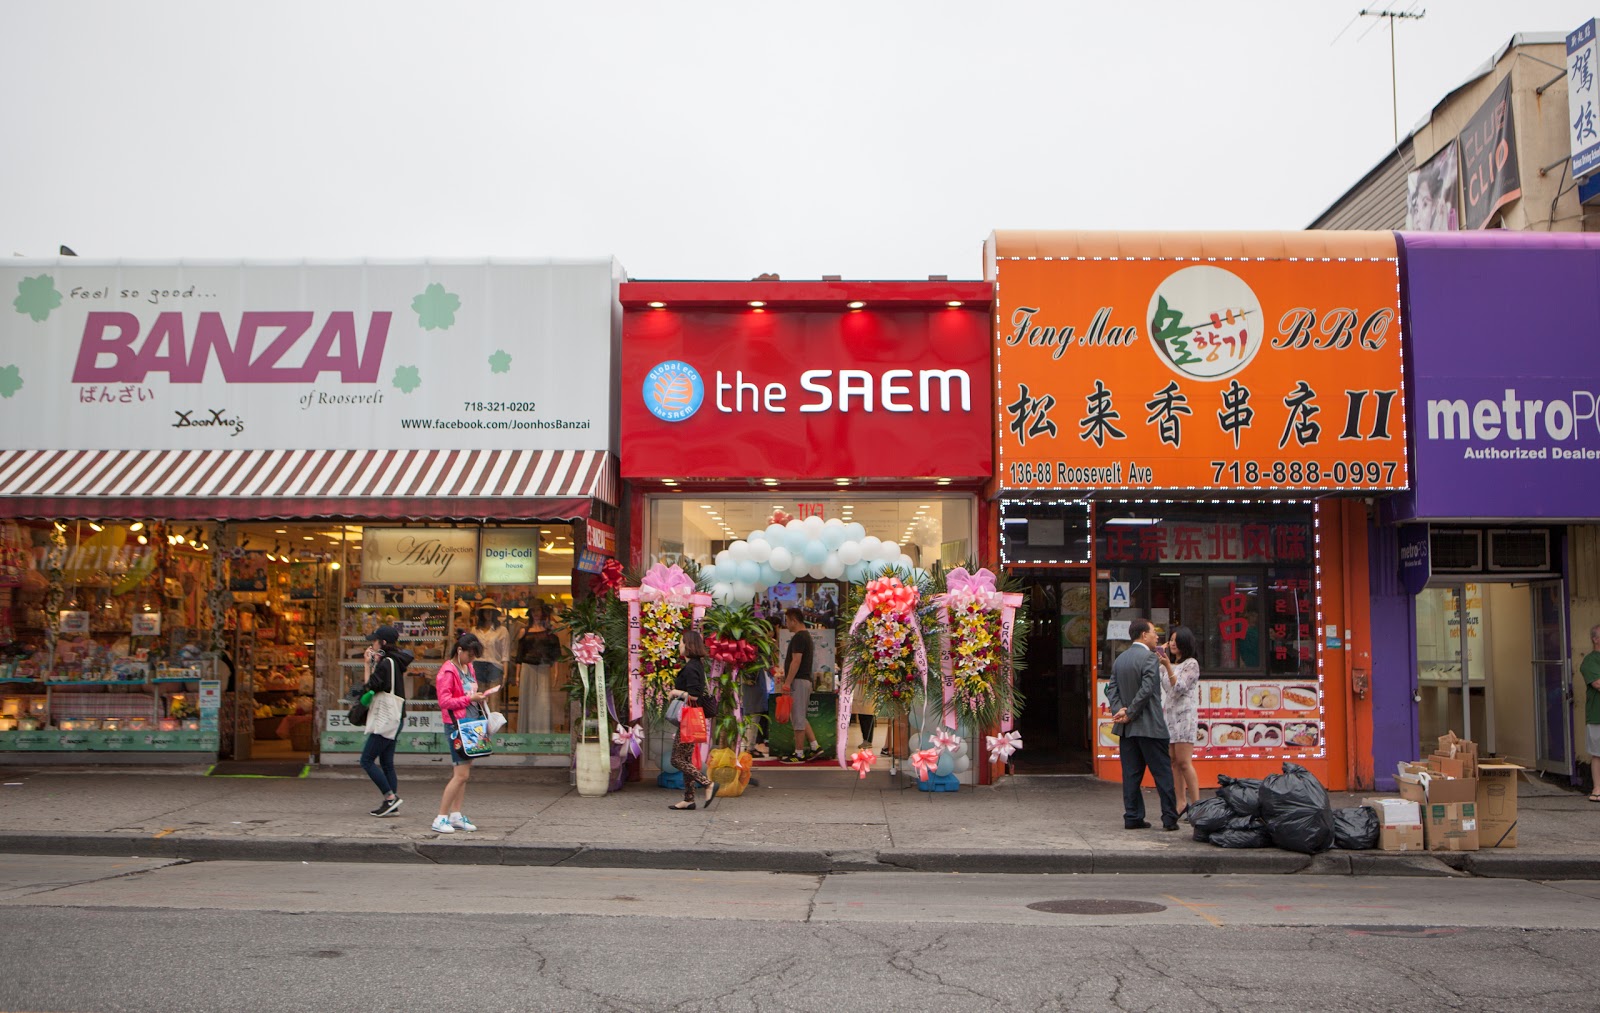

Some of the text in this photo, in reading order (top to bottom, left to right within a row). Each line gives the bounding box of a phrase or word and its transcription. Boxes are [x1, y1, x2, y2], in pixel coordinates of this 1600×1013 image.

[1572, 47, 1597, 146] 駕校
[1469, 138, 1509, 207] CLIO
[70, 286, 109, 299] Feel
[120, 289, 140, 298] so
[1006, 305, 1139, 360] Feng Mao
[1271, 307, 1394, 351] BBQ
[72, 311, 393, 383] BANZAI
[649, 363, 698, 381] global eco
[79, 385, 154, 403] ばんざい
[299, 390, 384, 410] of Roosevelt
[716, 369, 971, 413] the SAEM
[464, 401, 536, 412] 718-321-0202
[653, 405, 693, 419] the SAEM
[1007, 378, 1398, 450] 松来香串店 II
[1427, 388, 1600, 441] metroP
[401, 418, 591, 431] WWW.facebook.com/JoonhosBanzai
[1464, 447, 1547, 459] Authorized
[1010, 461, 1153, 484] 136-88 Roosevelt Ave
[1211, 461, 1398, 484] 718-888-0997
[485, 548, 532, 559] Dogi-Codi
[1104, 524, 1306, 561] 正宗东北风味
[1400, 540, 1428, 560] metroPCS
[387, 535, 455, 578] Ashy
[1113, 585, 1126, 600] A
[1219, 581, 1249, 660] 串
[1450, 626, 1477, 638] netrk.
